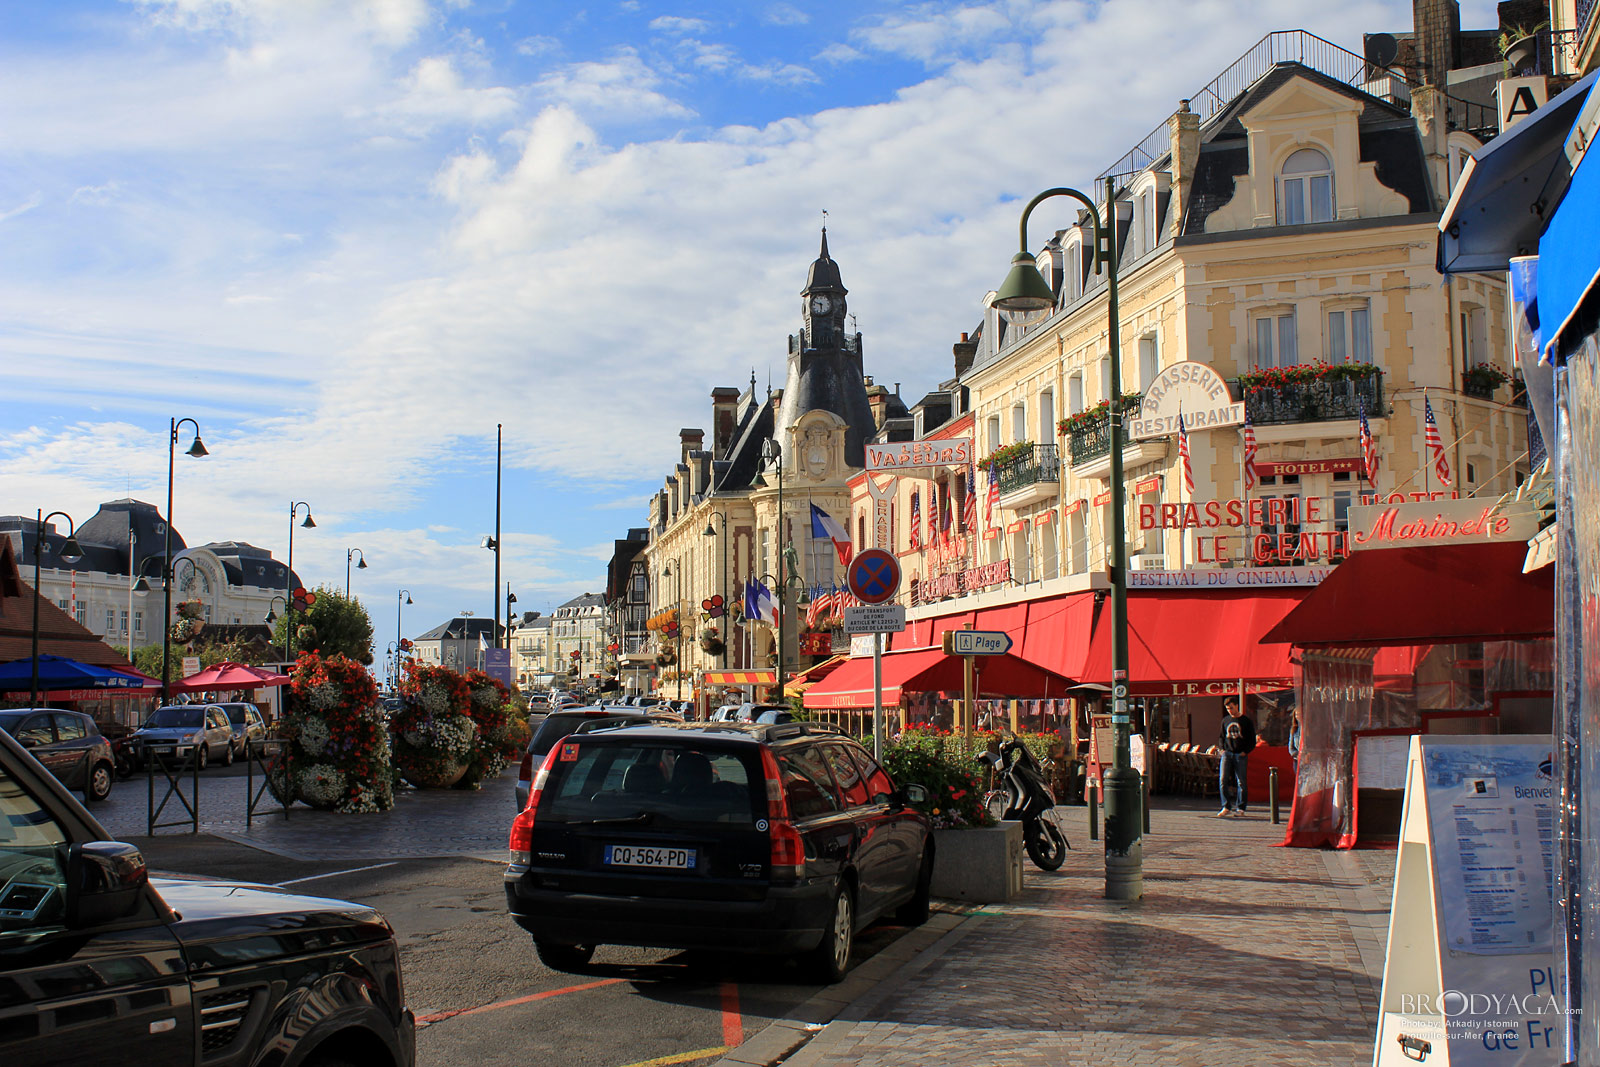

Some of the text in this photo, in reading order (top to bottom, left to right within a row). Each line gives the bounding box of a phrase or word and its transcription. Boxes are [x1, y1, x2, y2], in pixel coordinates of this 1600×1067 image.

[1144, 364, 1224, 414] BRASSERIE
[1133, 405, 1240, 437] RESTAURANT
[869, 441, 966, 467] VAPEURS
[901, 443, 932, 454] LES
[1273, 464, 1330, 475] HOTEL
[1139, 496, 1322, 530] BRASSERIE
[1197, 535, 1230, 563] LE
[1131, 572, 1199, 586] FESTIVAL
[1207, 571, 1228, 585] DU
[975, 636, 1001, 651] Plage
[1171, 683, 1199, 696] LE
[537, 852, 566, 860] VOLVO
[613, 847, 687, 866] CQ-564-PD
